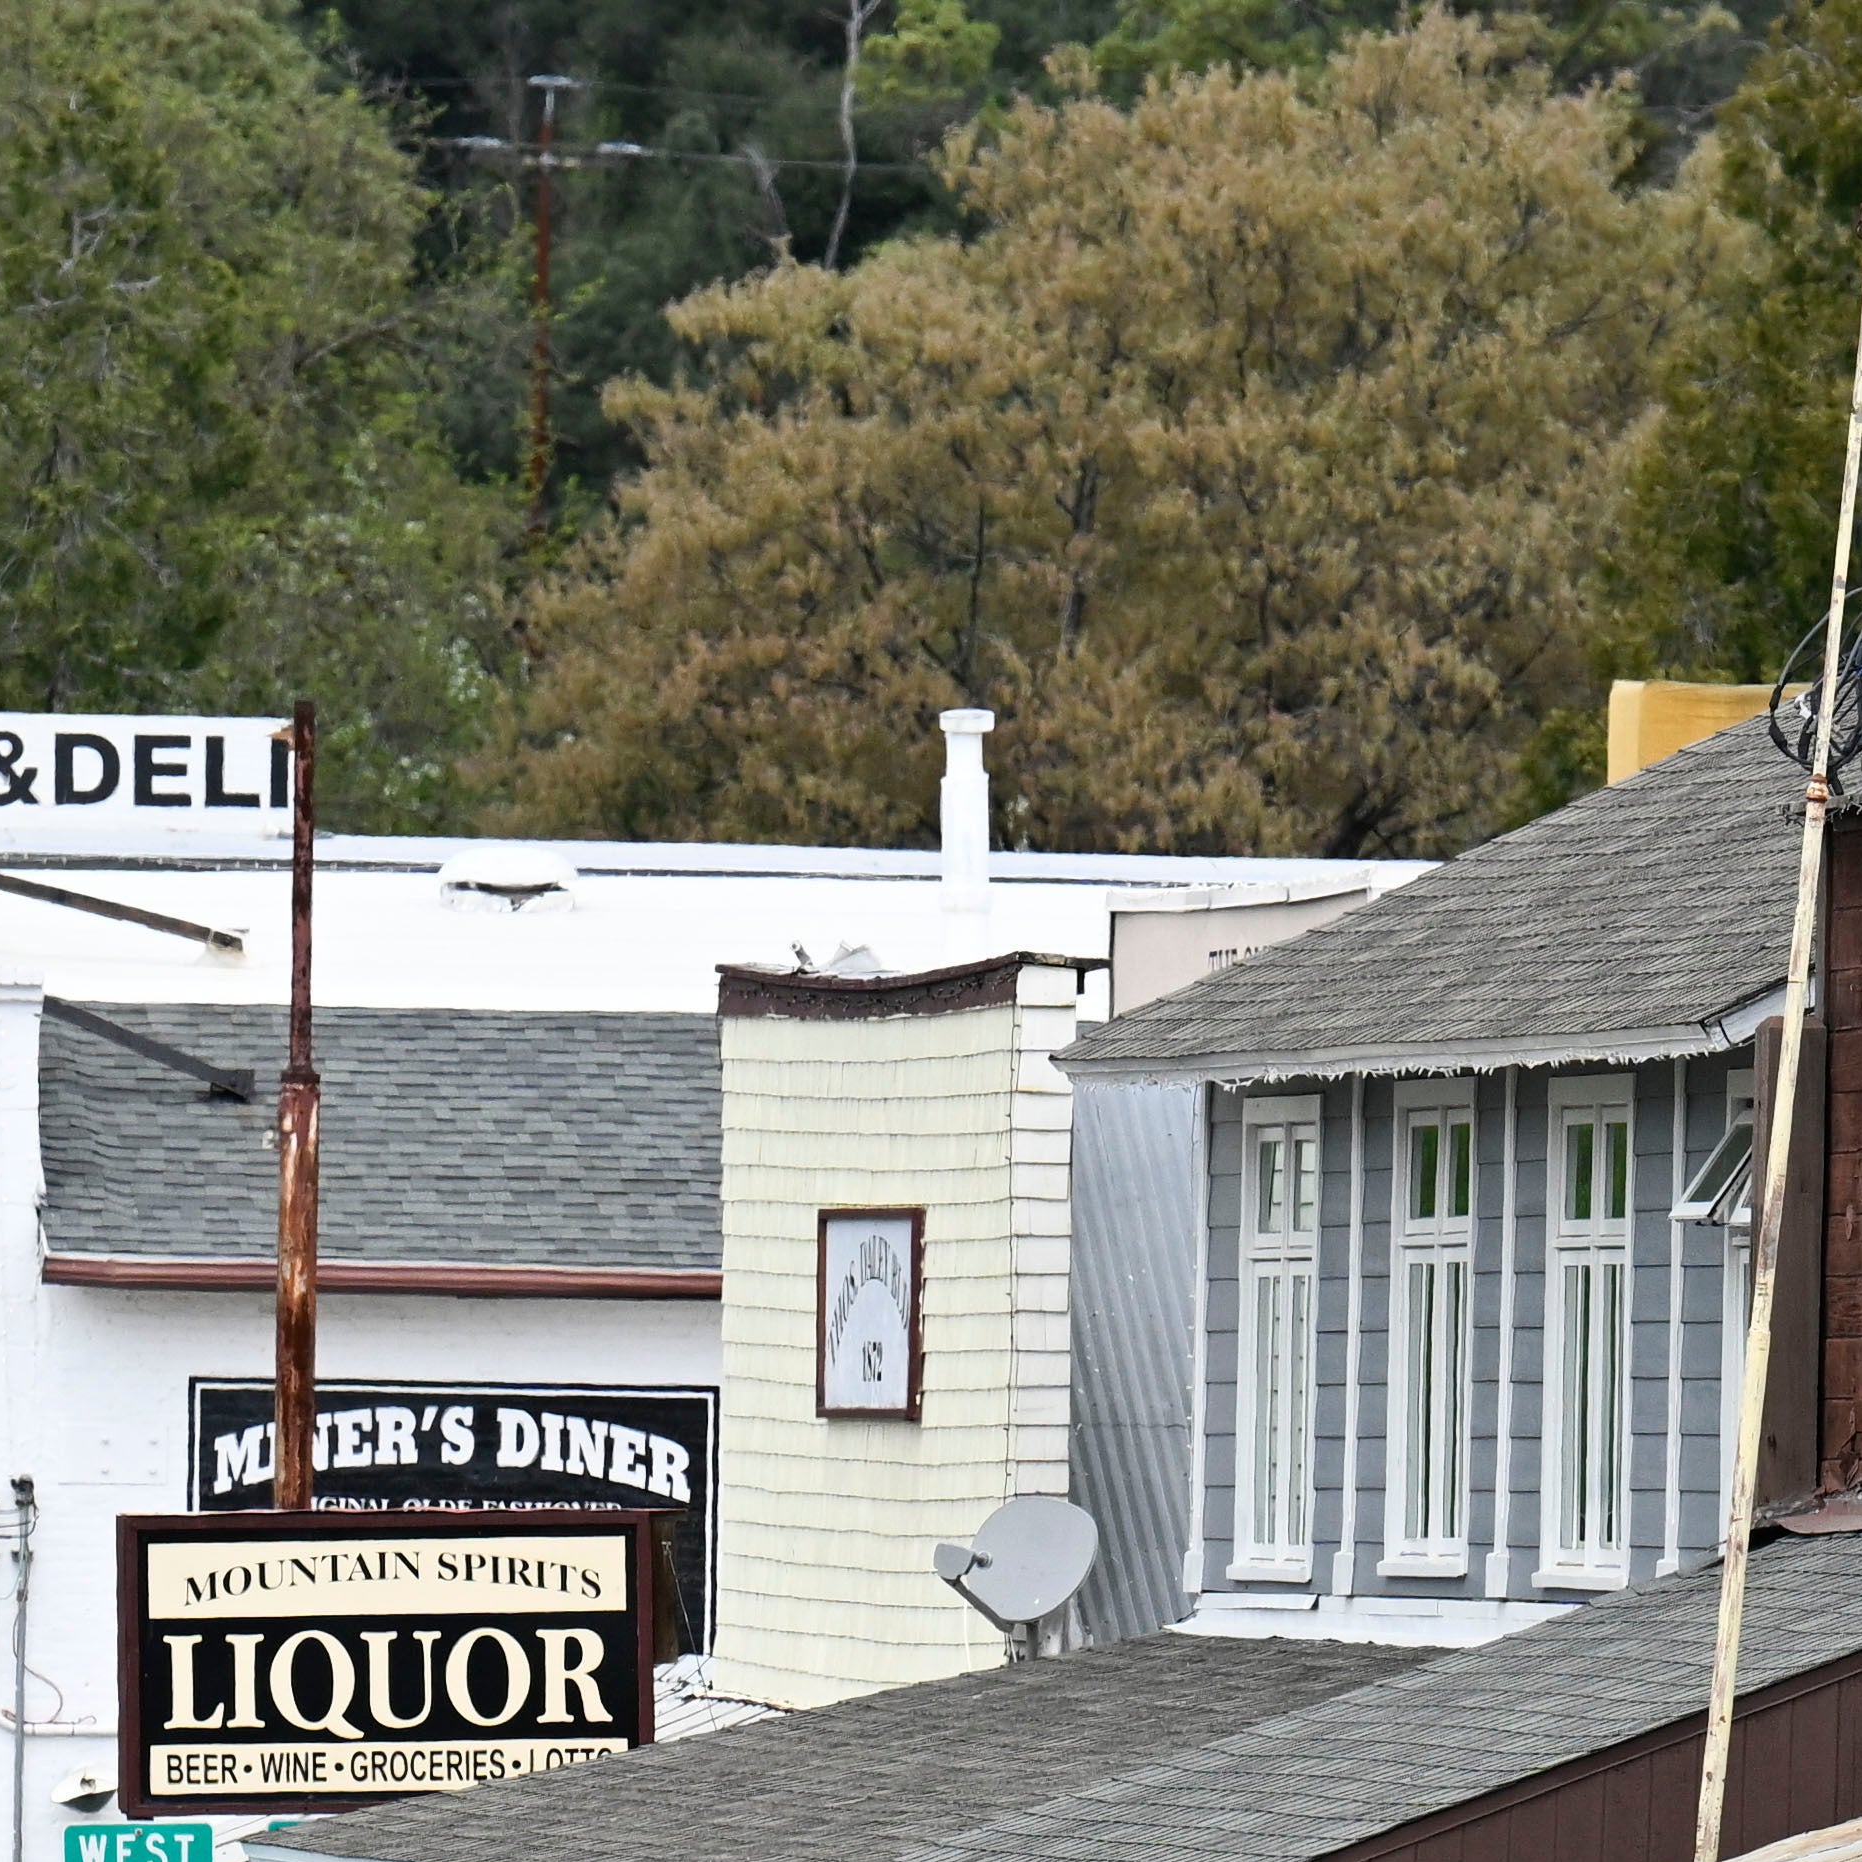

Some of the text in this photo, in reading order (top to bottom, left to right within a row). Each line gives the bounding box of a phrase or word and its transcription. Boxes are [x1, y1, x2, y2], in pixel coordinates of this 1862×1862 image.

[496, 1406, 692, 1505] DINER
[184, 1550, 603, 1607] MOUNTAIN SPIRITS
[161, 1626, 615, 1740] LIQUOR
[166, 1746, 613, 1785] BEER WINE GROCERIES LOTT
